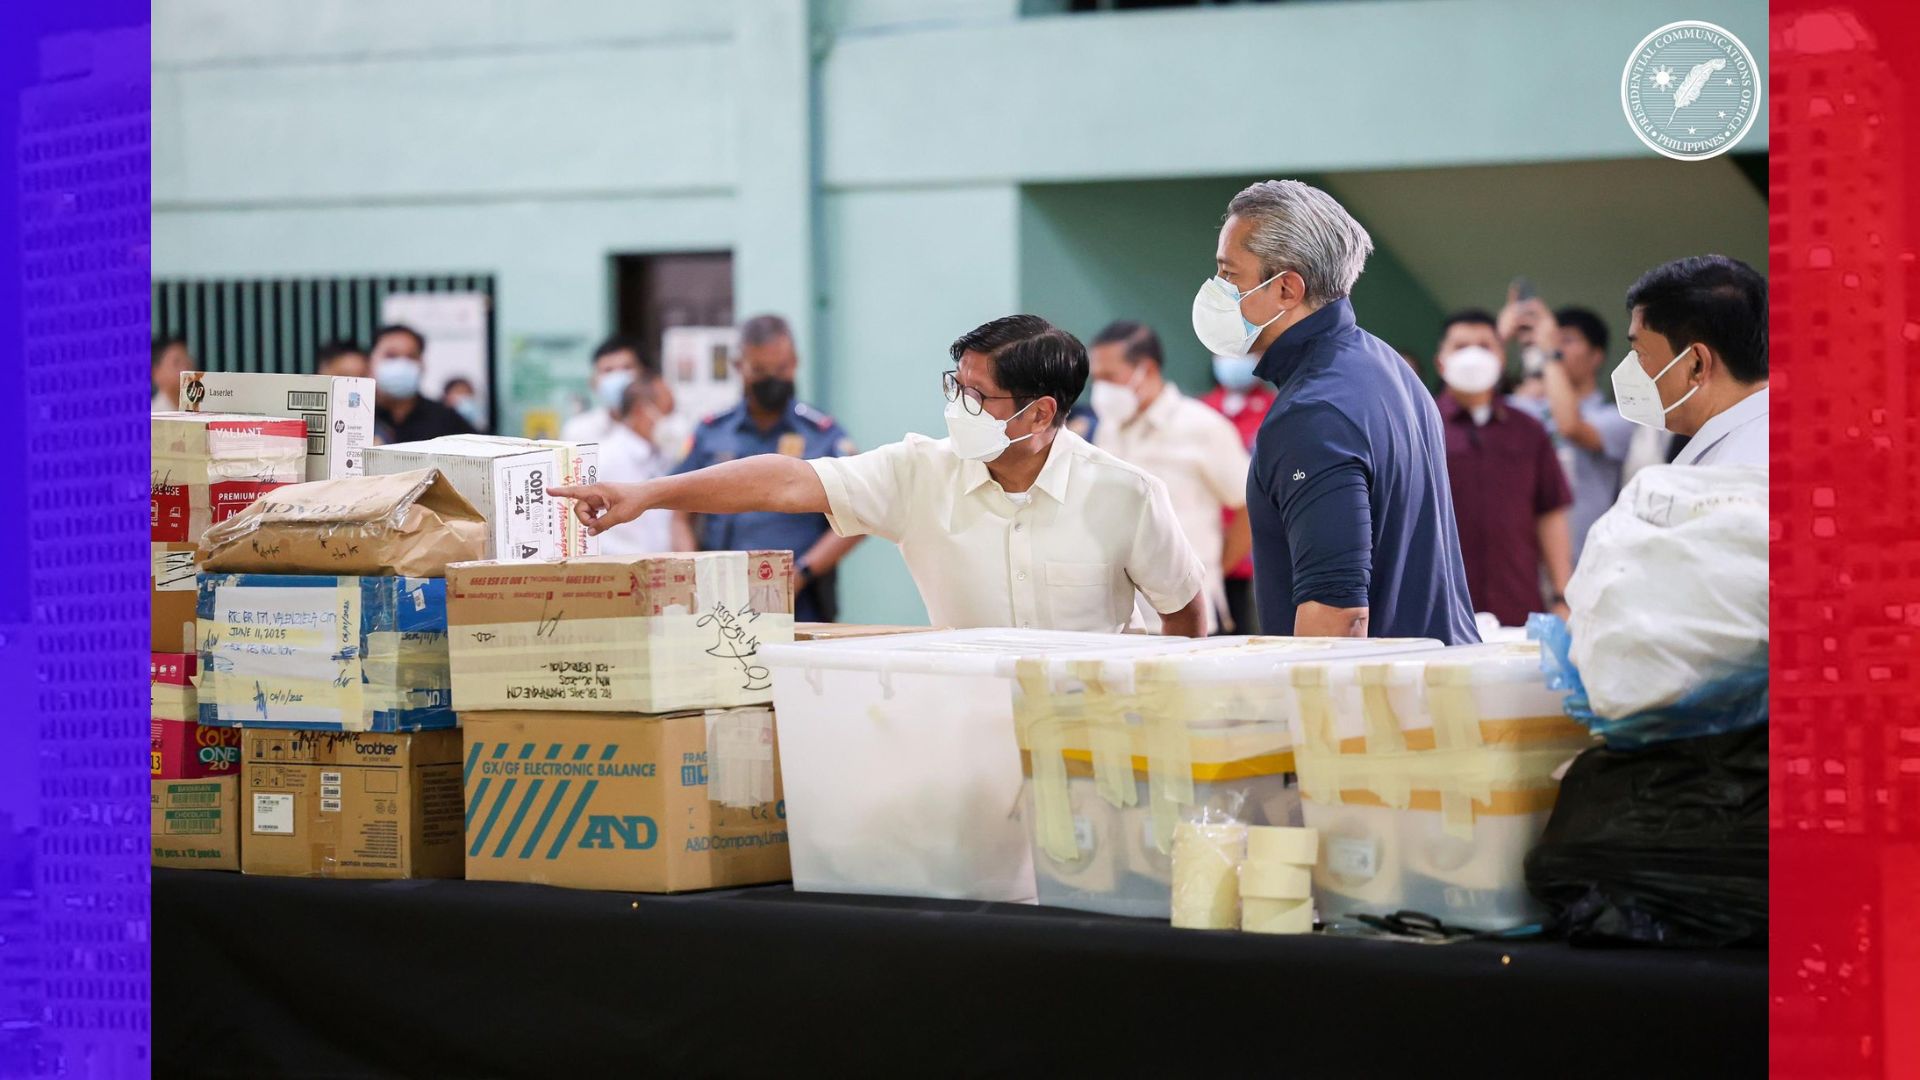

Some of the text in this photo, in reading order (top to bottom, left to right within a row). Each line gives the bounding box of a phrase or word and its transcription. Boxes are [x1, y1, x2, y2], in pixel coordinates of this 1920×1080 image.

[209, 388, 234, 398] LaserJet
[215, 427, 263, 438] VALIANT
[1292, 468, 1306, 481] alo
[530, 470, 543, 505] COPY
[218, 491, 255, 501] PREMIUM
[515, 495, 525, 515] 24
[229, 627, 252, 638] JUNE
[195, 725, 241, 747] COPY
[200, 747, 239, 763] ONE
[355, 742, 398, 756] brother
[208, 760, 230, 771] 20
[482, 761, 656, 777] GX/GF ELECTRONIC BALANCE
